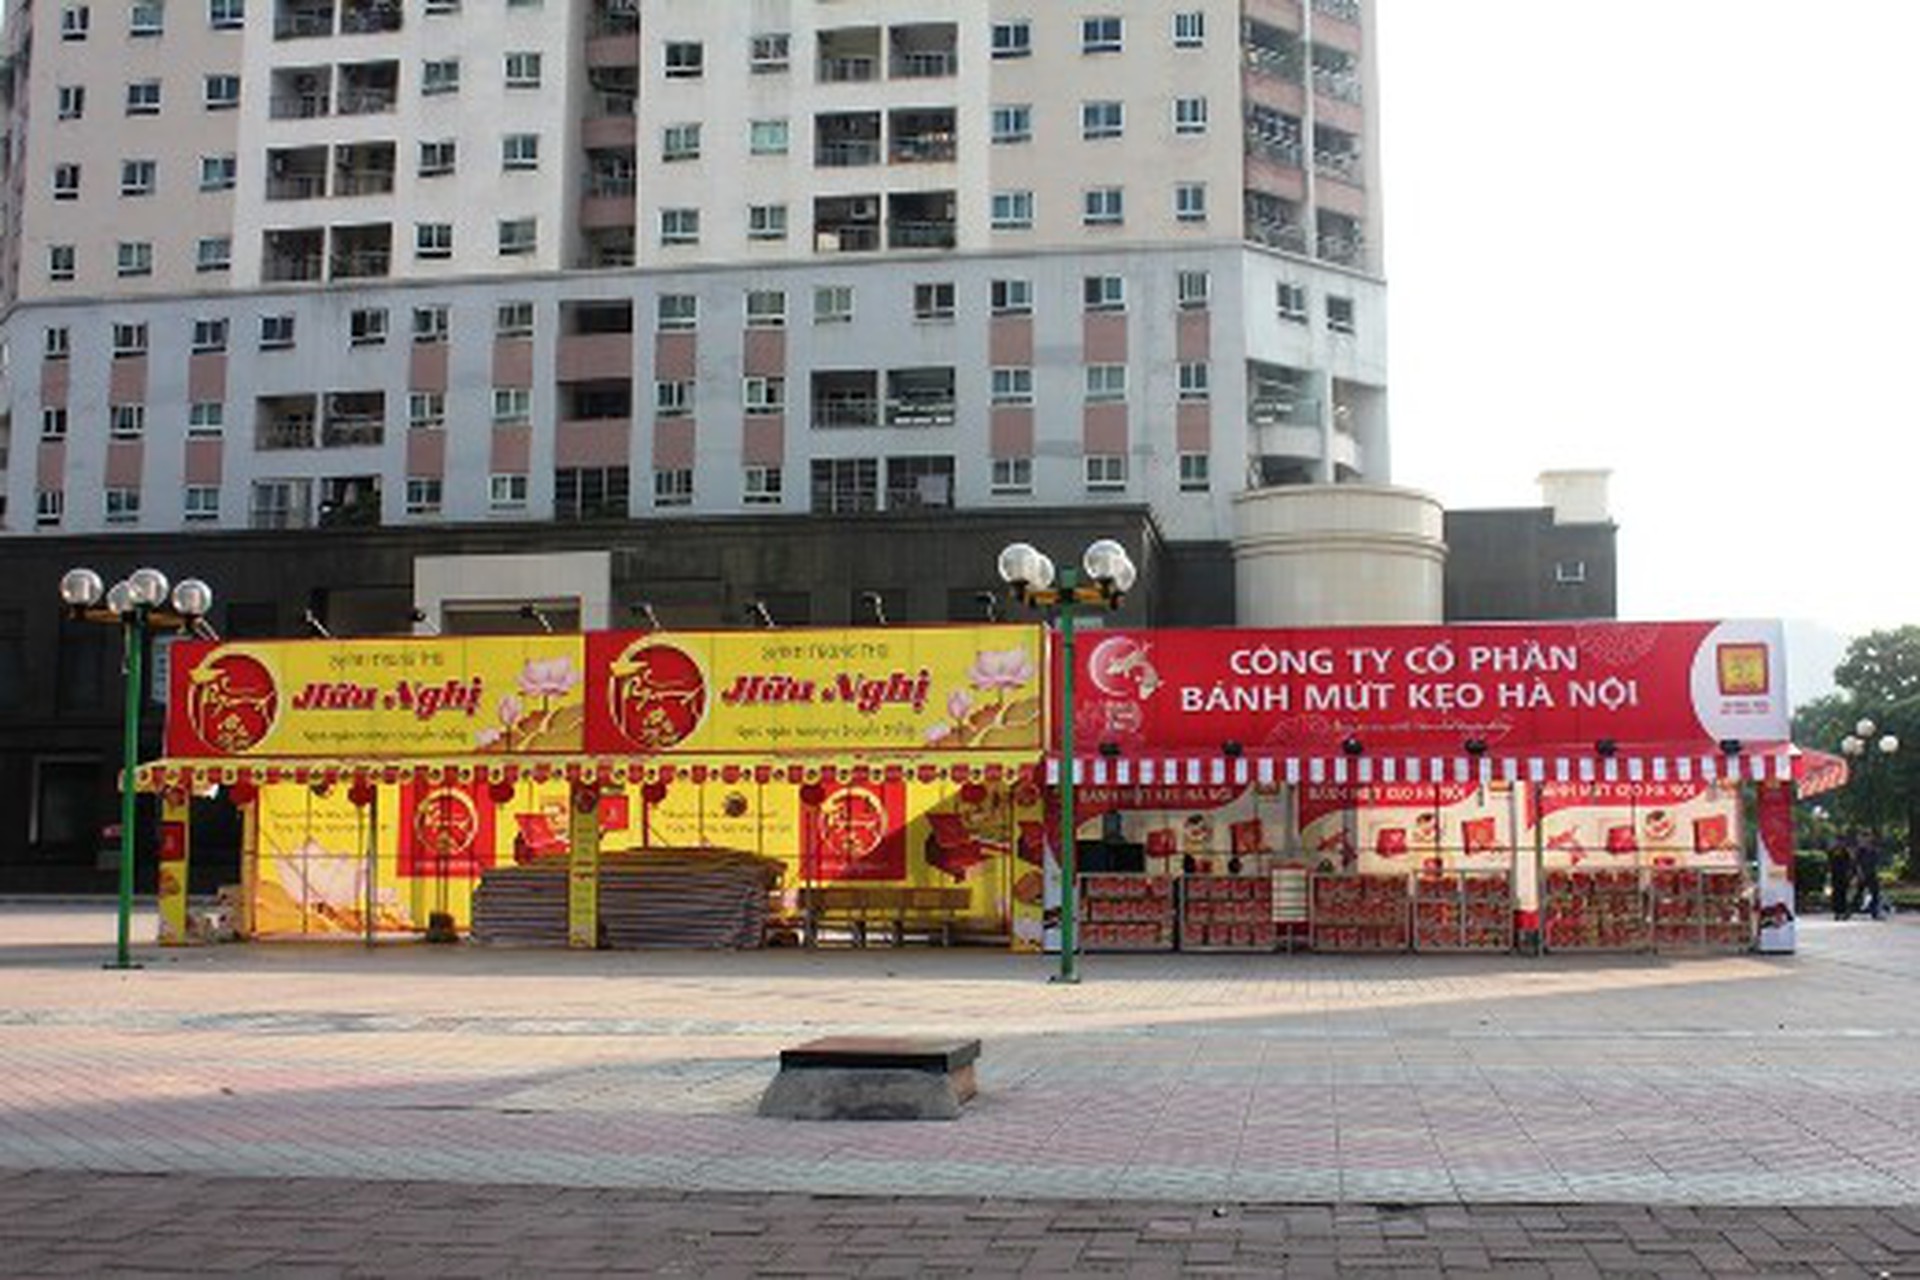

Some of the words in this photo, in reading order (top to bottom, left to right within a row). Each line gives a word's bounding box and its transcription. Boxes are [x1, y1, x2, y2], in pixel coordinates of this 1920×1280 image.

[1230, 644, 1333, 675] CÔNG
[1347, 649, 1392, 674] TY
[1468, 640, 1578, 672] PHẦN
[1180, 680, 1289, 711] BÁNH
[1408, 682, 1484, 714] KẸO
[1497, 676, 1555, 708] HÀ
[1568, 676, 1638, 711] NỘI
